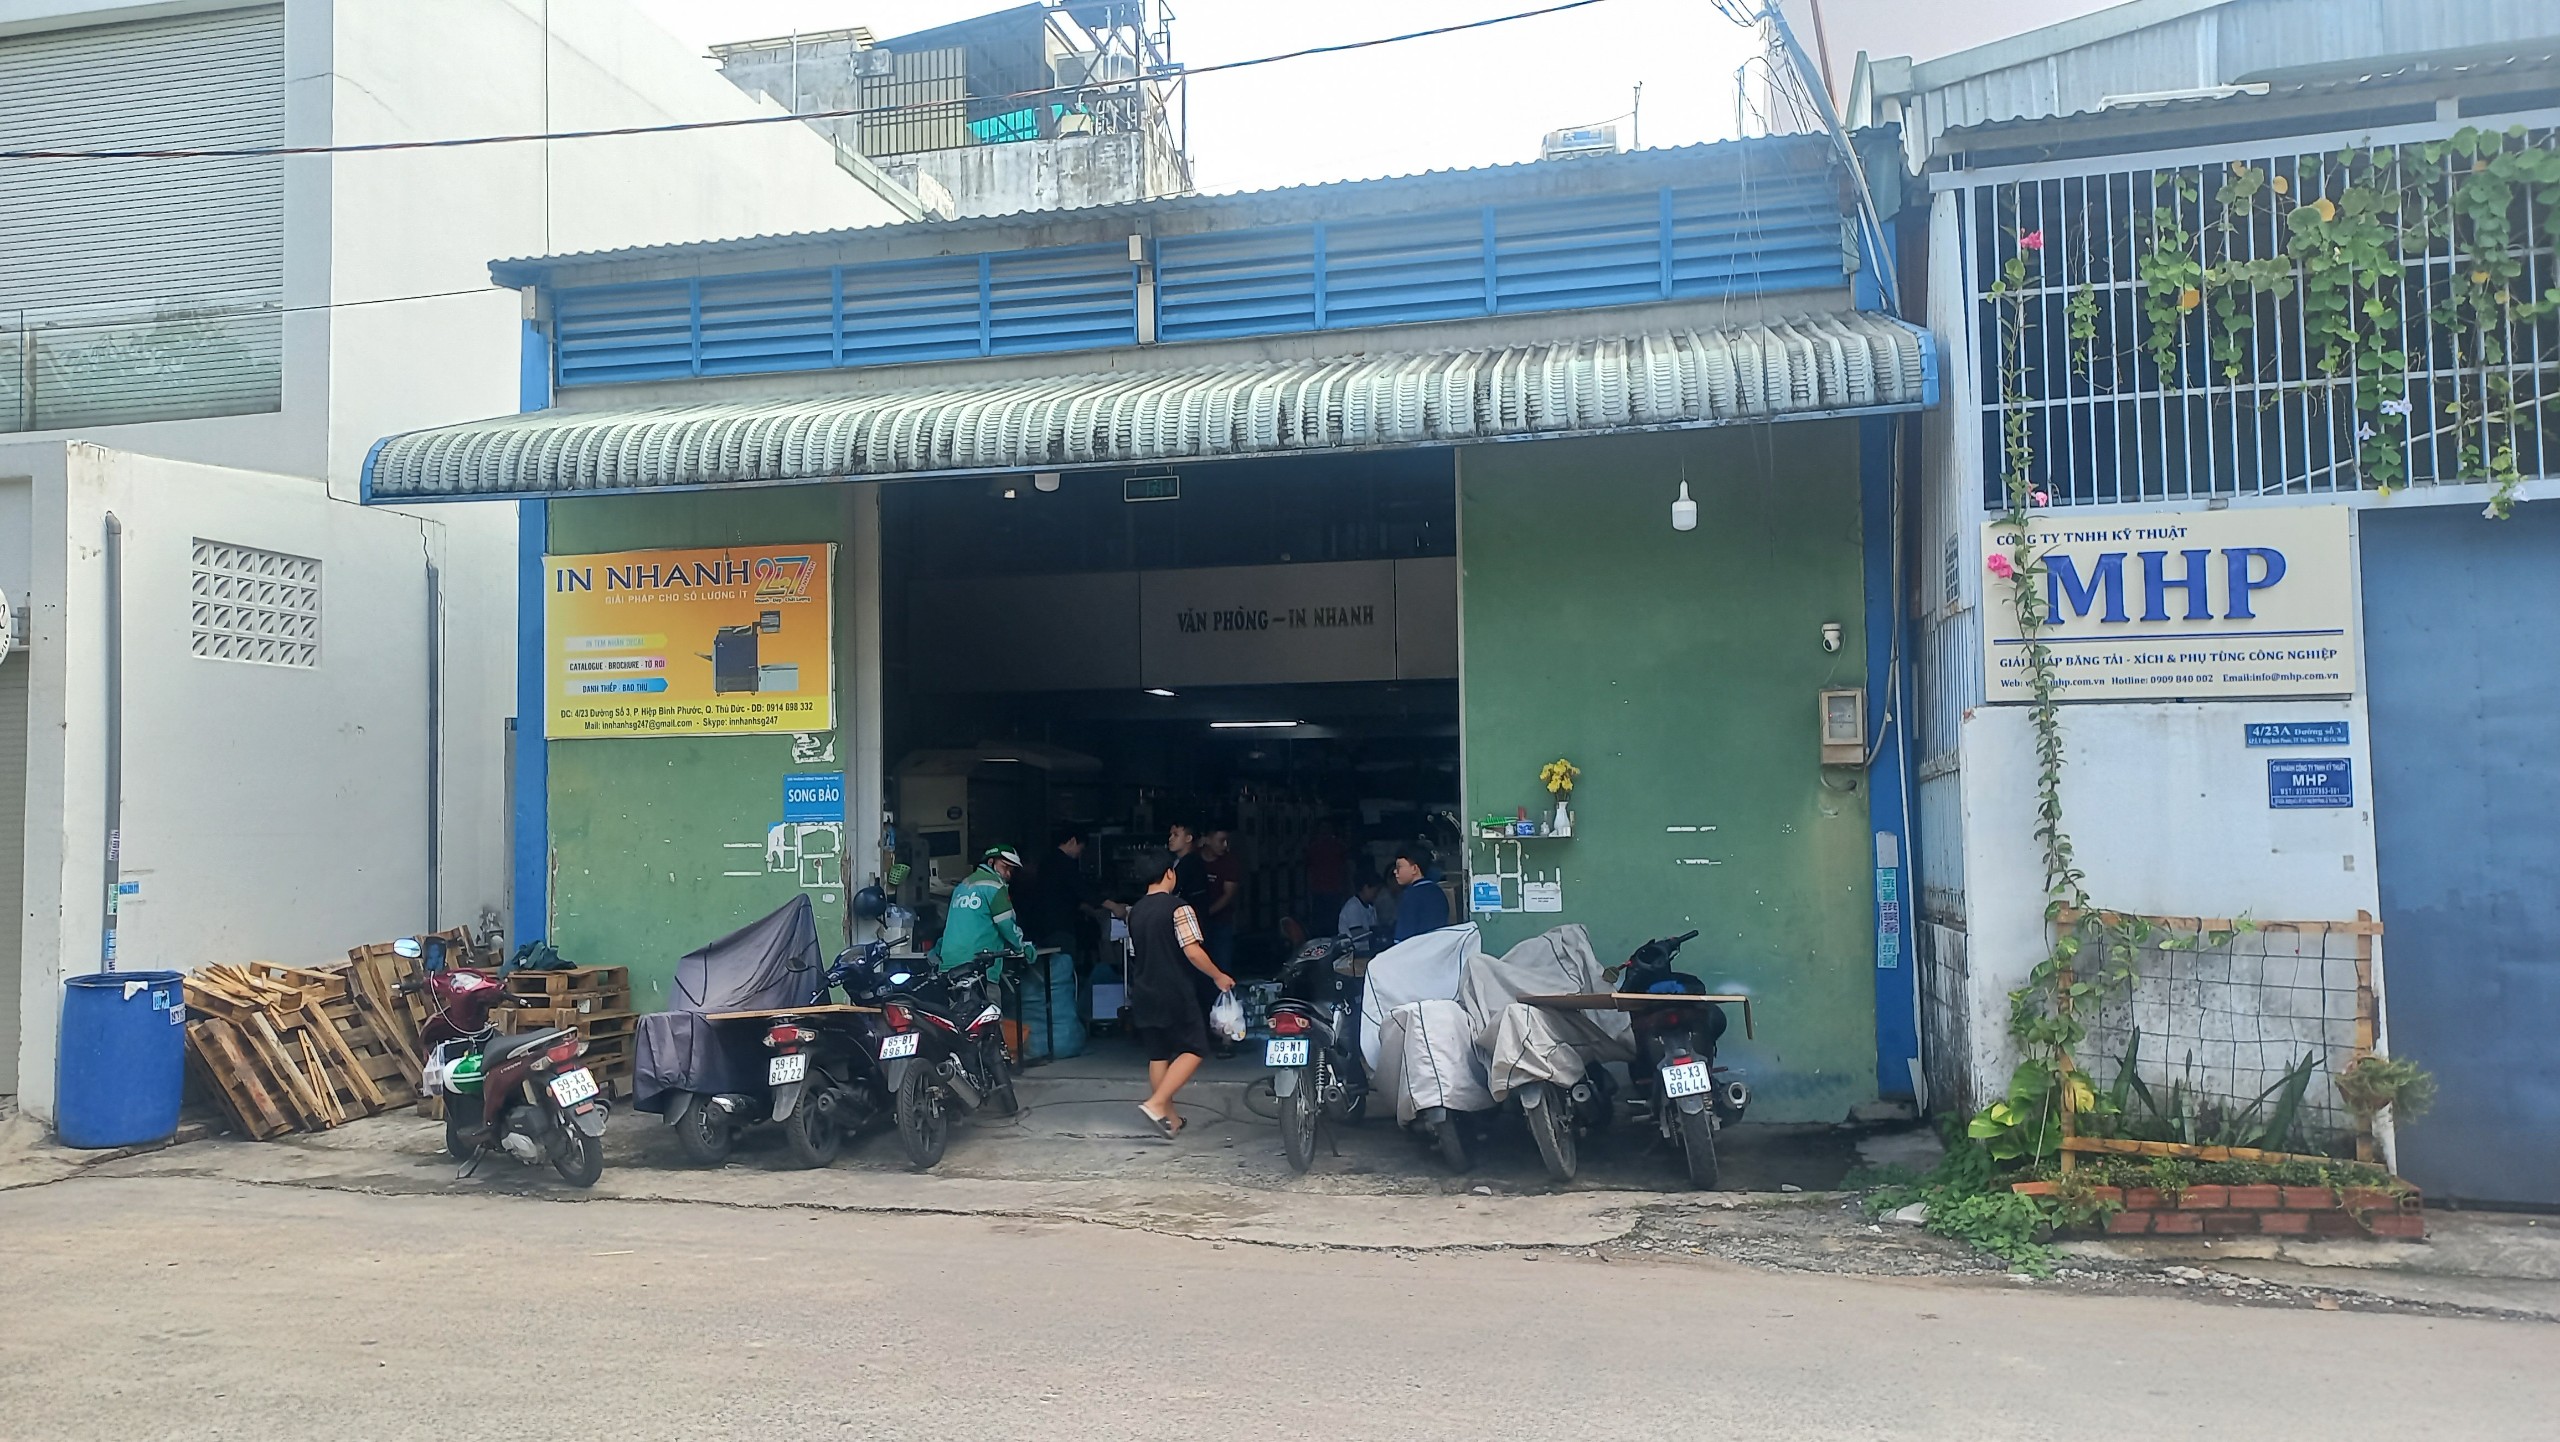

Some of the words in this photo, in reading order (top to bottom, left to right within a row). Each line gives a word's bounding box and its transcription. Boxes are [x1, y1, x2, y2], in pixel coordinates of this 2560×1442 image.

[1997, 533, 2036, 546] CÔG
[2040, 533, 2060, 544] TY
[2064, 531, 2107, 543] TNHH
[2112, 528, 2131, 541] KỸ
[2136, 525, 2187, 541] THUẬT
[557, 568, 592, 592] IN
[605, 560, 750, 590] NHANH
[754, 555, 810, 596] 247
[2041, 547, 2287, 625] MHP
[658, 593, 680, 602] CHO
[683, 591, 697, 601] SỐ
[1177, 608, 1207, 633] VĂN
[1213, 606, 1269, 631] PHÒNG
[1289, 608, 1307, 628] IN
[1314, 605, 1374, 627] NHANH
[2000, 657, 2025, 668] GIẢI
[2066, 654, 2100, 666] BĂNG
[2103, 653, 2123, 666] TẢI
[2133, 653, 2163, 664] XÍCH
[2167, 654, 2176, 663] &
[2180, 653, 2206, 664] PHỤ
[2210, 651, 2245, 662] TÙNG
[2249, 649, 2284, 661] CÔNG
[2287, 648, 2338, 660] NGHIỆP
[569, 662, 603, 671] CATALOGUE
[608, 661, 639, 669] BROCHURE
[583, 685, 599, 694] DANH
[601, 682, 617, 693] THIẾP
[622, 684, 635, 692] BAO
[2001, 679, 2023, 688] Web:
[2111, 676, 2147, 685] Hotline:
[2150, 675, 2173, 683] 0909
[2176, 674, 2193, 683] 840
[2196, 674, 2213, 683] 002
[575, 709, 588, 718] 4/23
[615, 706, 624, 717] Số
[641, 707, 657, 717] Hiệp
[658, 706, 675, 716] Bình
[705, 705, 713, 714] Q.
[766, 703, 783, 713] 0914
[800, 702, 813, 711] 332
[584, 722, 600, 730] Mail:
[703, 717, 727, 728] Skype:
[729, 716, 778, 727] innhanhsg247
[2252, 726, 2291, 736] 4/23A
[2292, 773, 2327, 786] MHP
[788, 789, 817, 802] SONG
[818, 784, 840, 802] BẢO
[1274, 1042, 1301, 1052] 69-N1
[775, 1057, 798, 1070] 59-F1
[1269, 1053, 1304, 1064] 646.80
[771, 1068, 801, 1083] 847.22
[1670, 1065, 1701, 1081] 59-X3
[557, 1072, 586, 1091] 59-X3
